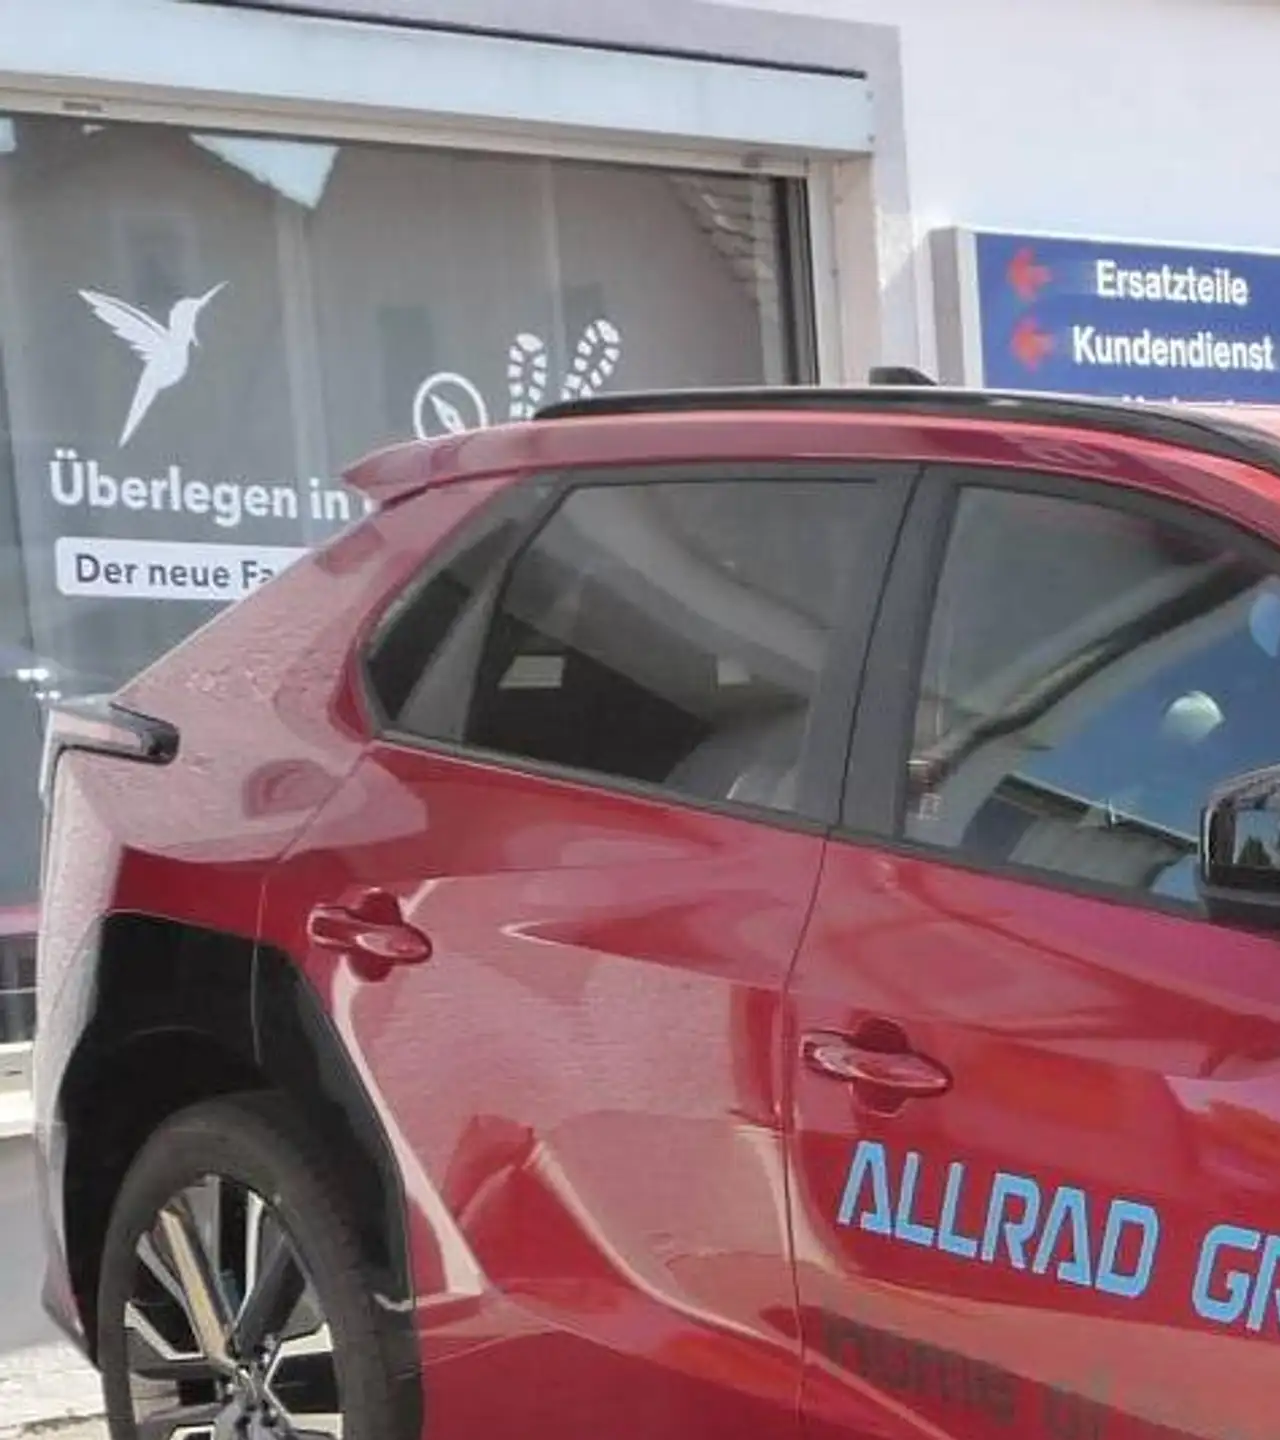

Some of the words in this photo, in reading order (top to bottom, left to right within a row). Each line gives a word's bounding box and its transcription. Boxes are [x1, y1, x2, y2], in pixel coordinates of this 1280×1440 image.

[1096, 259, 1250, 306] Ersatzteile
[1072, 324, 1277, 373] Kundendienst
[50, 448, 298, 527] Überlegen
[310, 478, 350, 520] in
[76, 553, 138, 584] Der
[149, 564, 231, 590] neue
[836, 1138, 1161, 1299] ALLRAD
